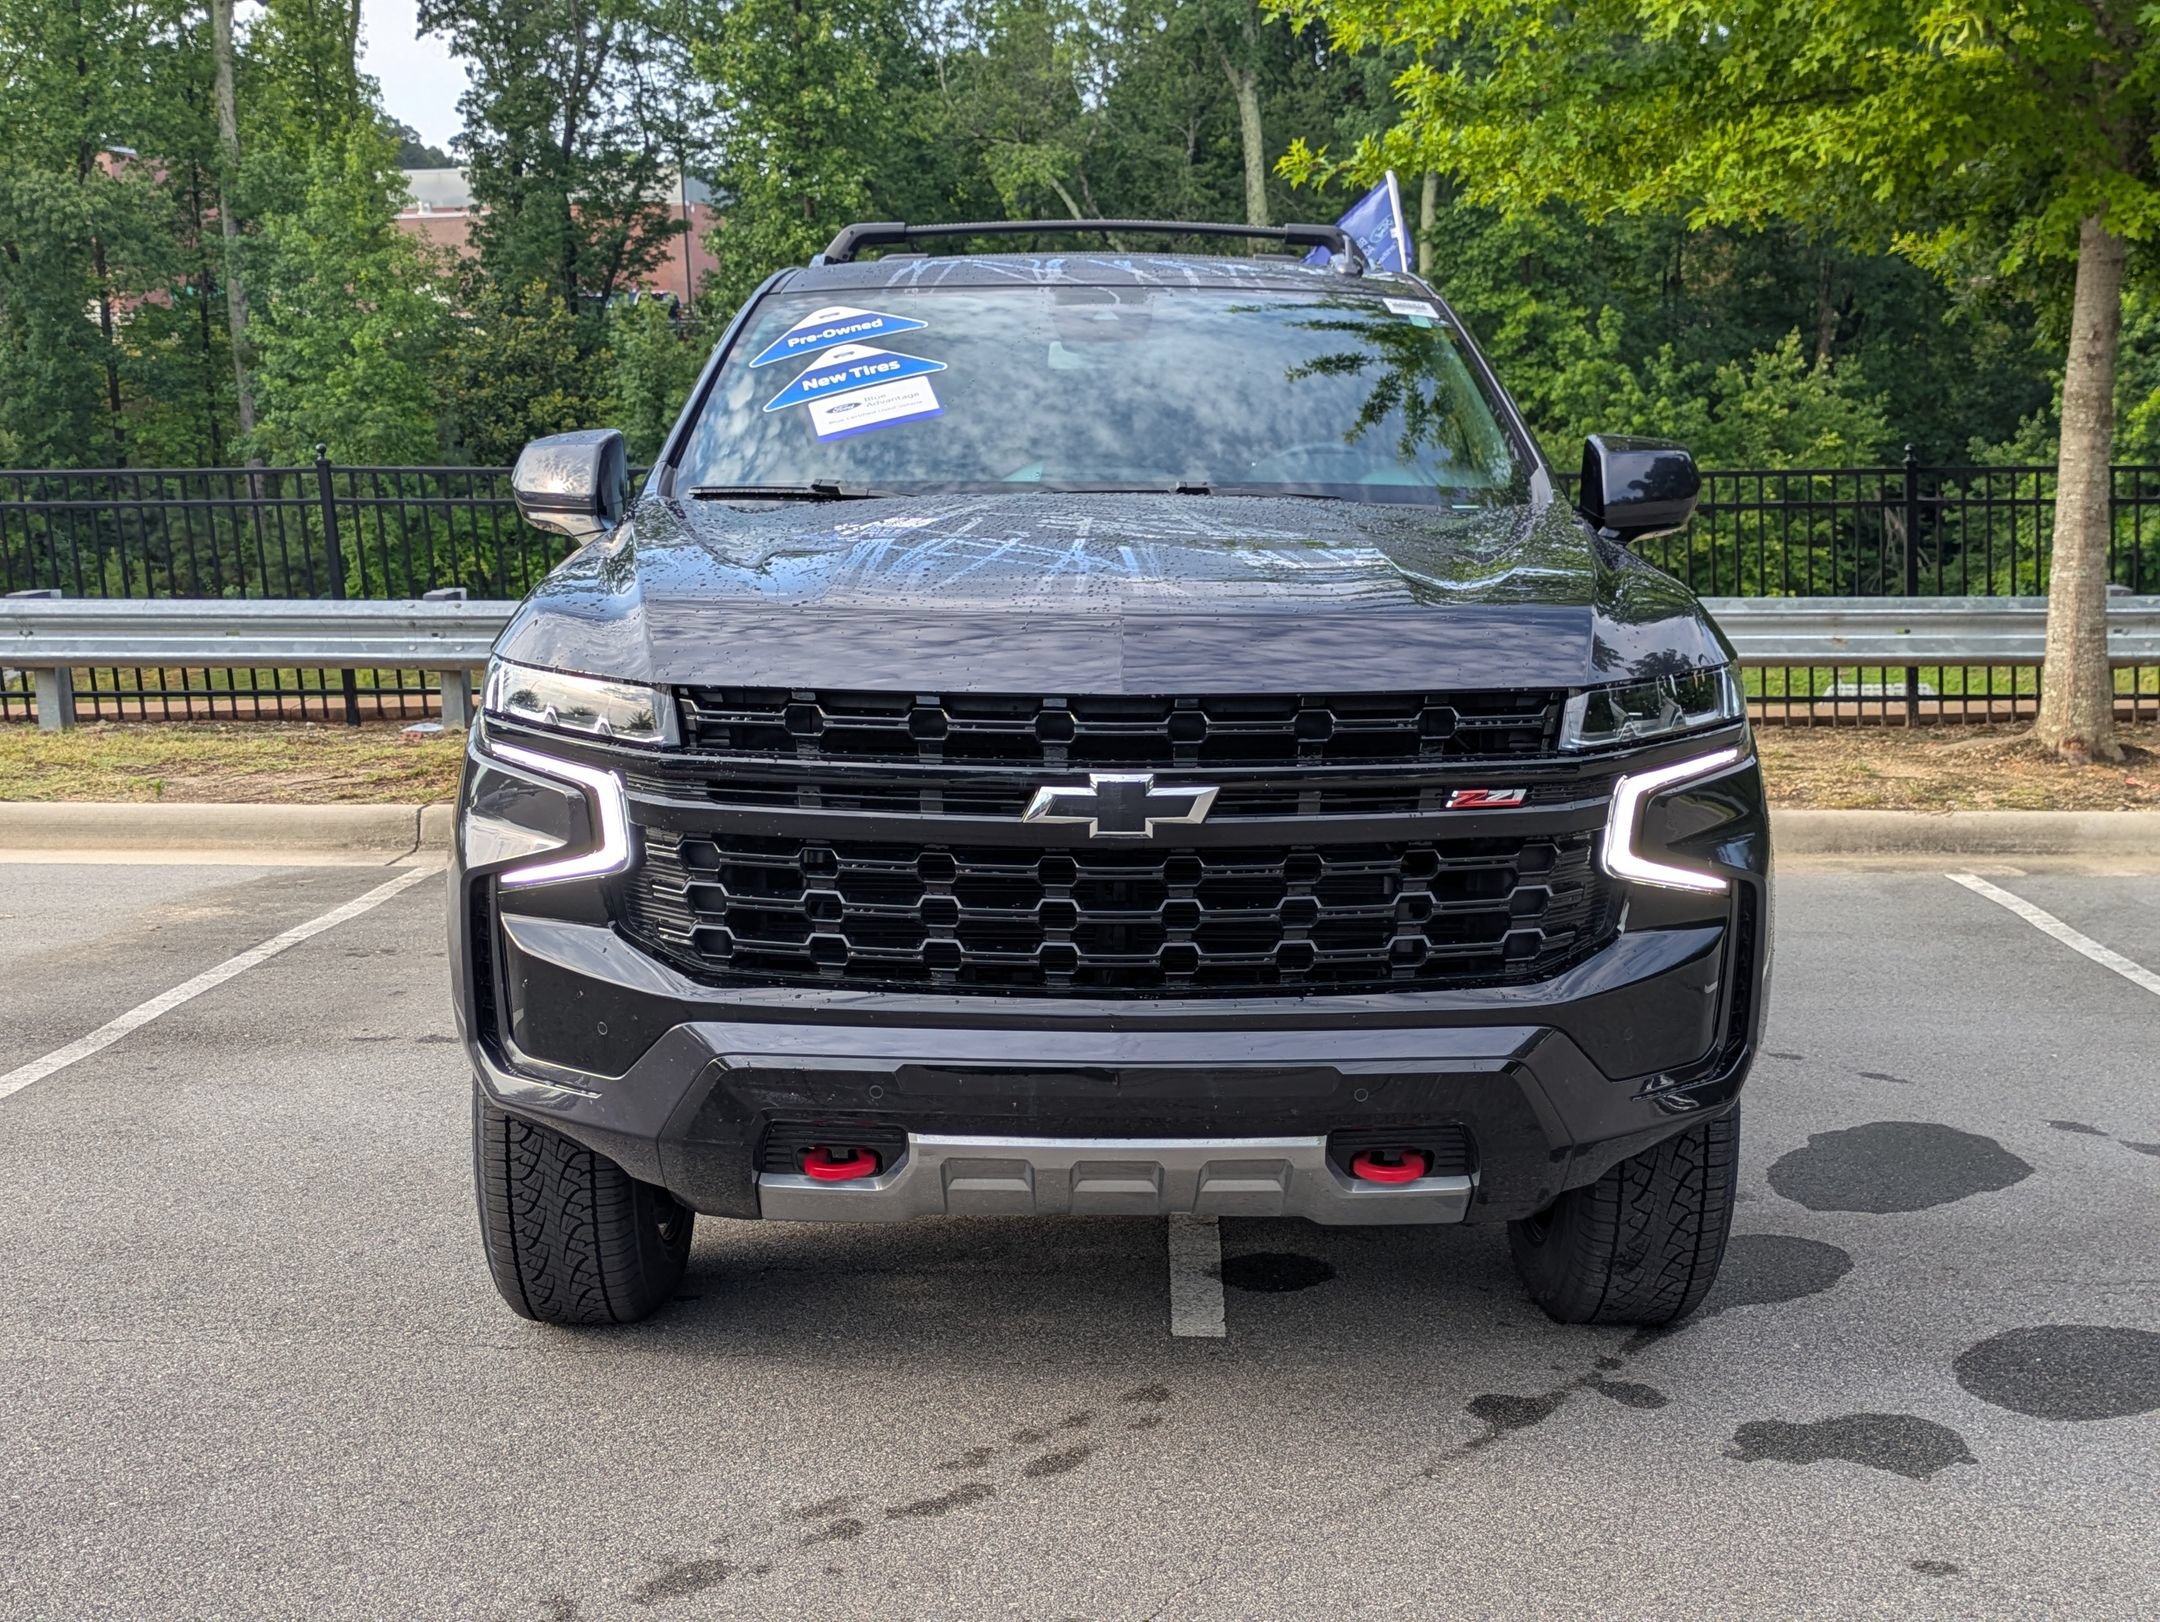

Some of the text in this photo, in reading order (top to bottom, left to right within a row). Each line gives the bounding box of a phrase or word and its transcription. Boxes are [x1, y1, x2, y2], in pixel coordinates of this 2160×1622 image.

[787, 318, 884, 348] Pre-Owned
[801, 360, 901, 392] New Tires
[866, 392, 920, 408] Advantage
[1446, 789, 1527, 808] Z71
